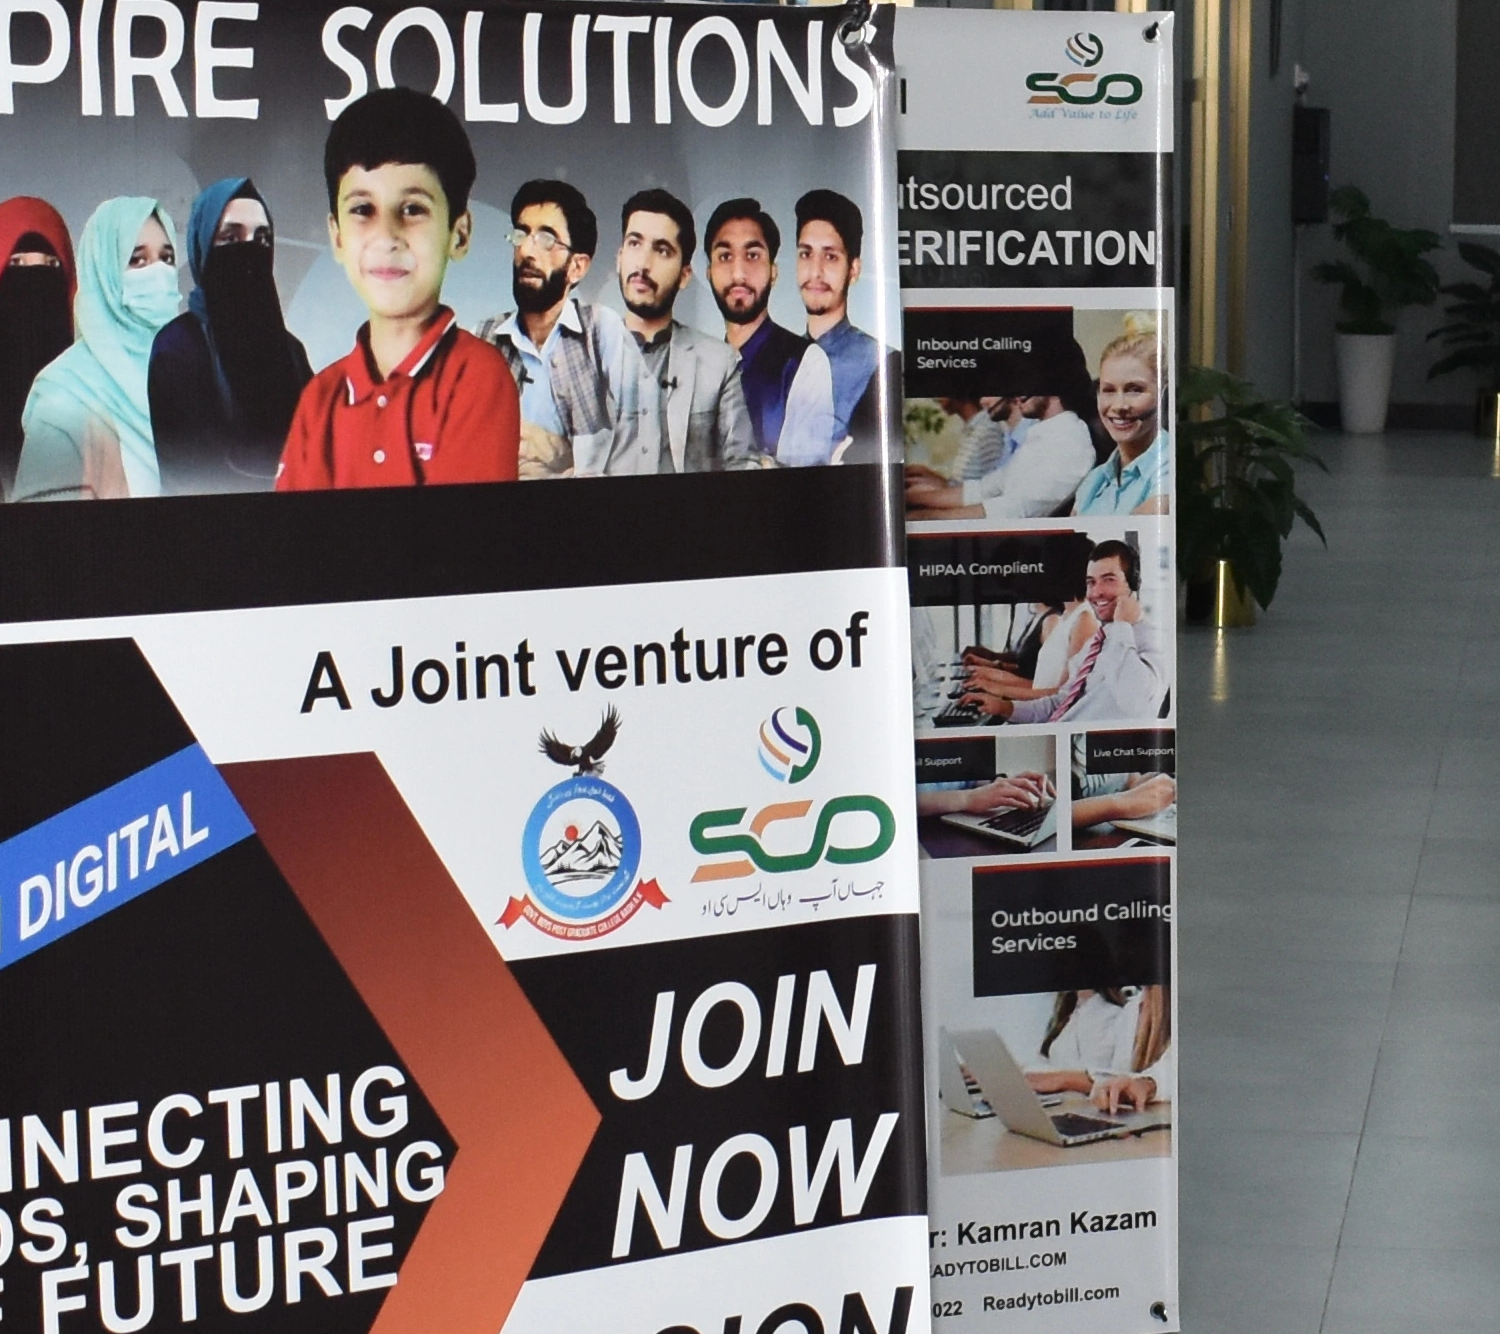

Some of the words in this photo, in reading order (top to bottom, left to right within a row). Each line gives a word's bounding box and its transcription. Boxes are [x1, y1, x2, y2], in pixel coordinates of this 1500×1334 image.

[322, 1, 876, 128] SOLUTIONS
[917, 338, 978, 350] Inbound
[982, 337, 1031, 352] Calling
[917, 356, 977, 368] Services
[920, 564, 966, 576] HIPAA
[969, 561, 1044, 576] Complient
[301, 651, 351, 713] A
[371, 639, 536, 707] Joint
[556, 628, 788, 691] venture
[810, 611, 869, 671] of
[20, 791, 208, 940] DIGITAL
[992, 904, 1098, 927] Outbound
[1104, 900, 1172, 923] Calling
[992, 933, 1076, 953] Services
[609, 964, 876, 1101] JOIN
[115, 1140, 444, 1248] SHAPING
[612, 1113, 899, 1258] NOW
[958, 1220, 1060, 1245] Kamran
[1071, 1211, 1156, 1234] Kazam
[984, 1287, 1119, 1311] Readytobill.com
